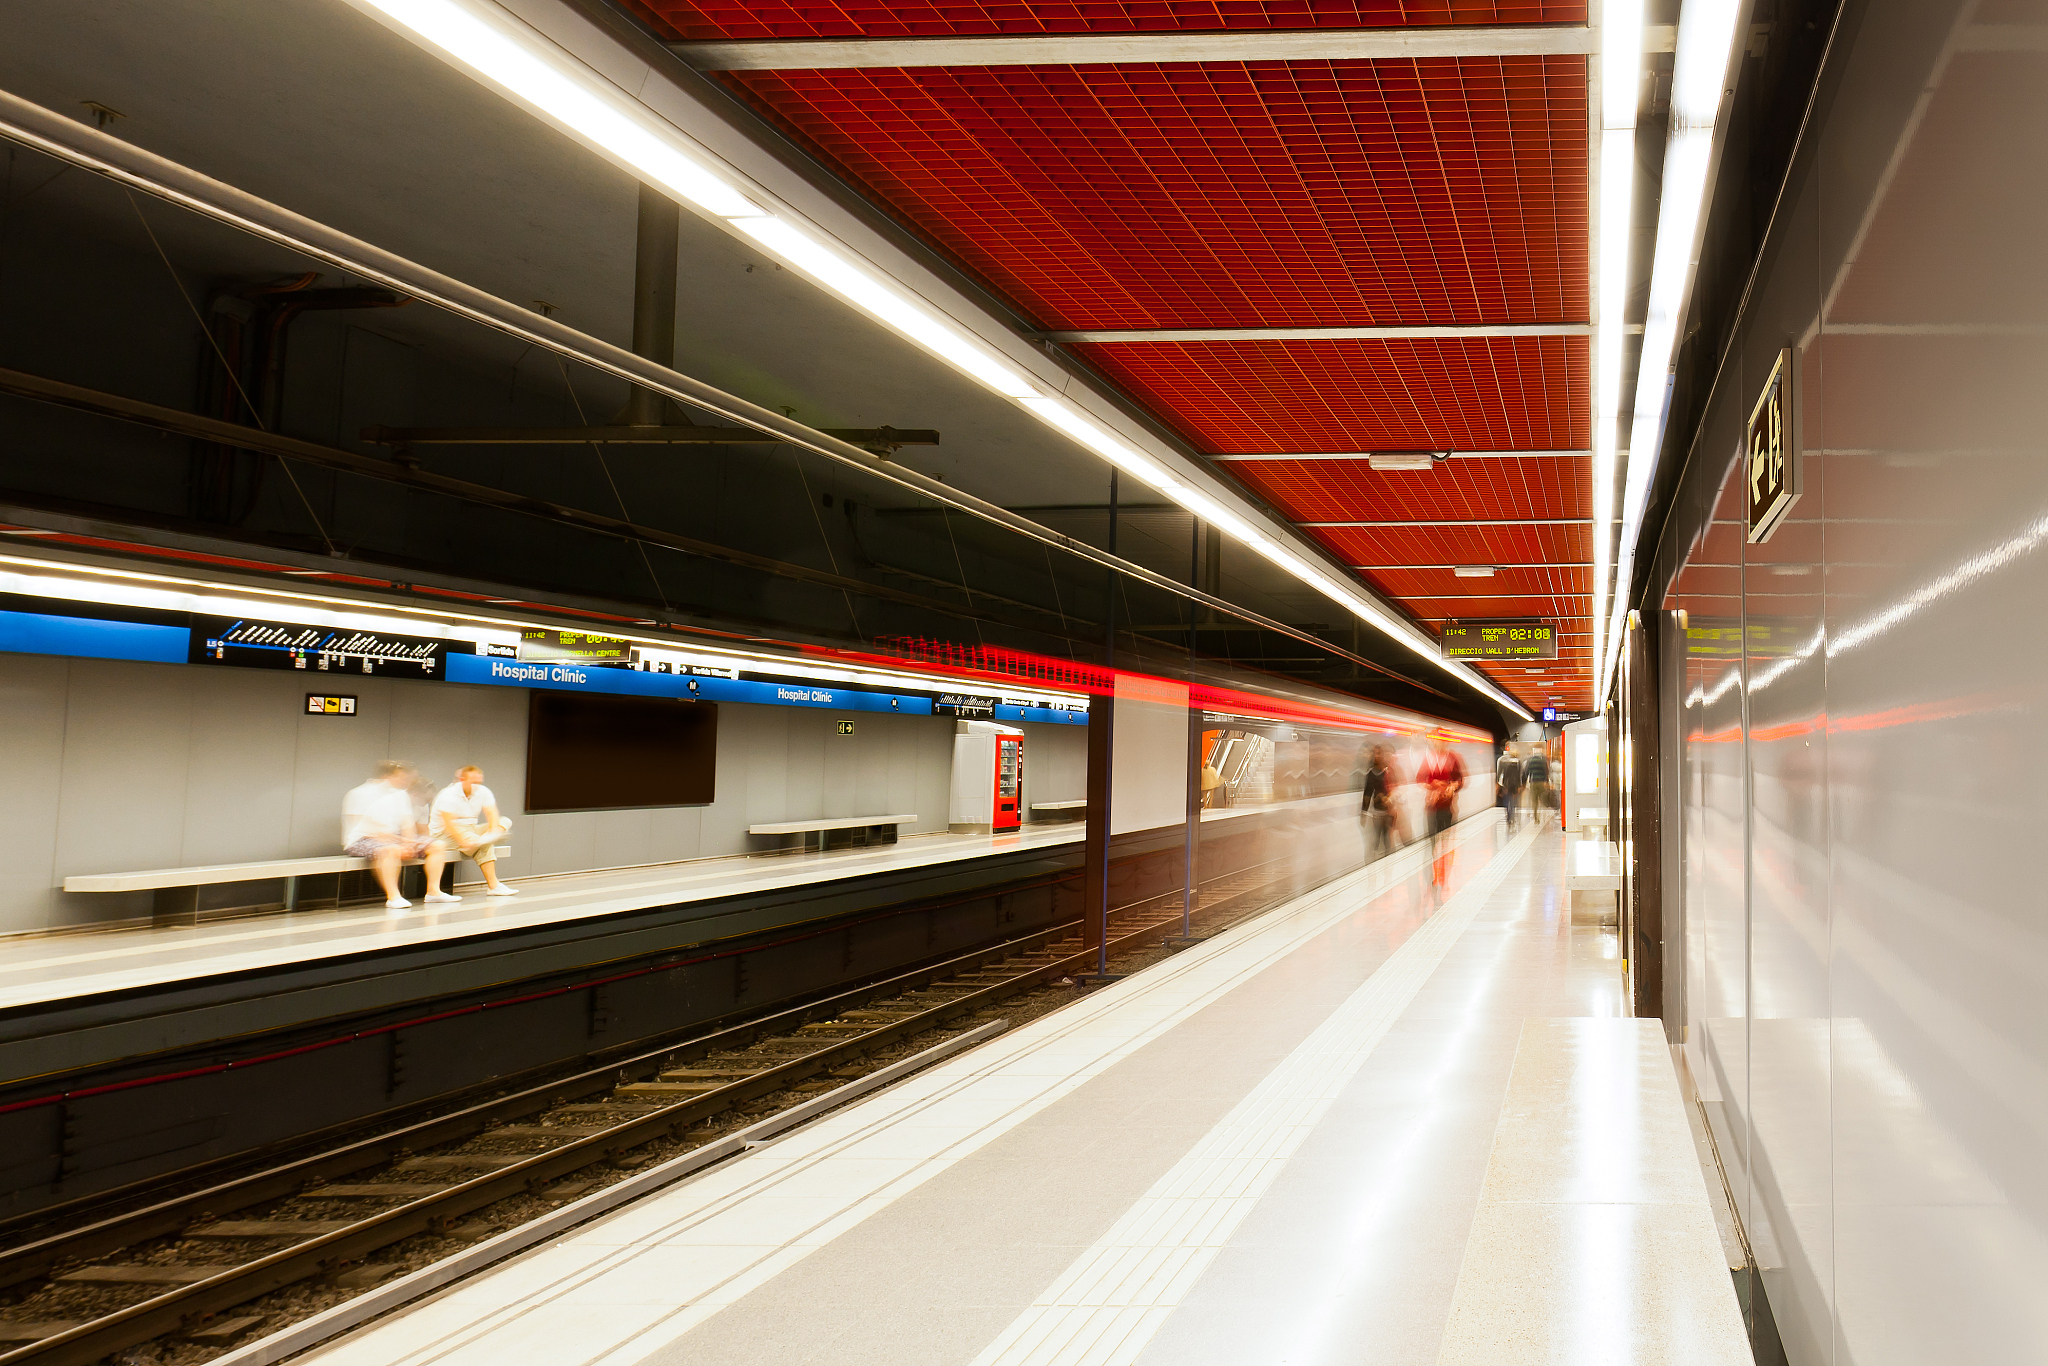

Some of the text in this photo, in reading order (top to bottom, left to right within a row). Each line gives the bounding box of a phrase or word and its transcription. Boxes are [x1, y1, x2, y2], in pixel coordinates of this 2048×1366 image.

[1482, 634, 1499, 642] TREN
[487, 645, 515, 656] Sortida
[596, 649, 622, 657] CENTRE
[1486, 647, 1503, 655] VALL
[492, 662, 587, 684] Hospital Clínic
[777, 688, 833, 703] Hospital Clínic
